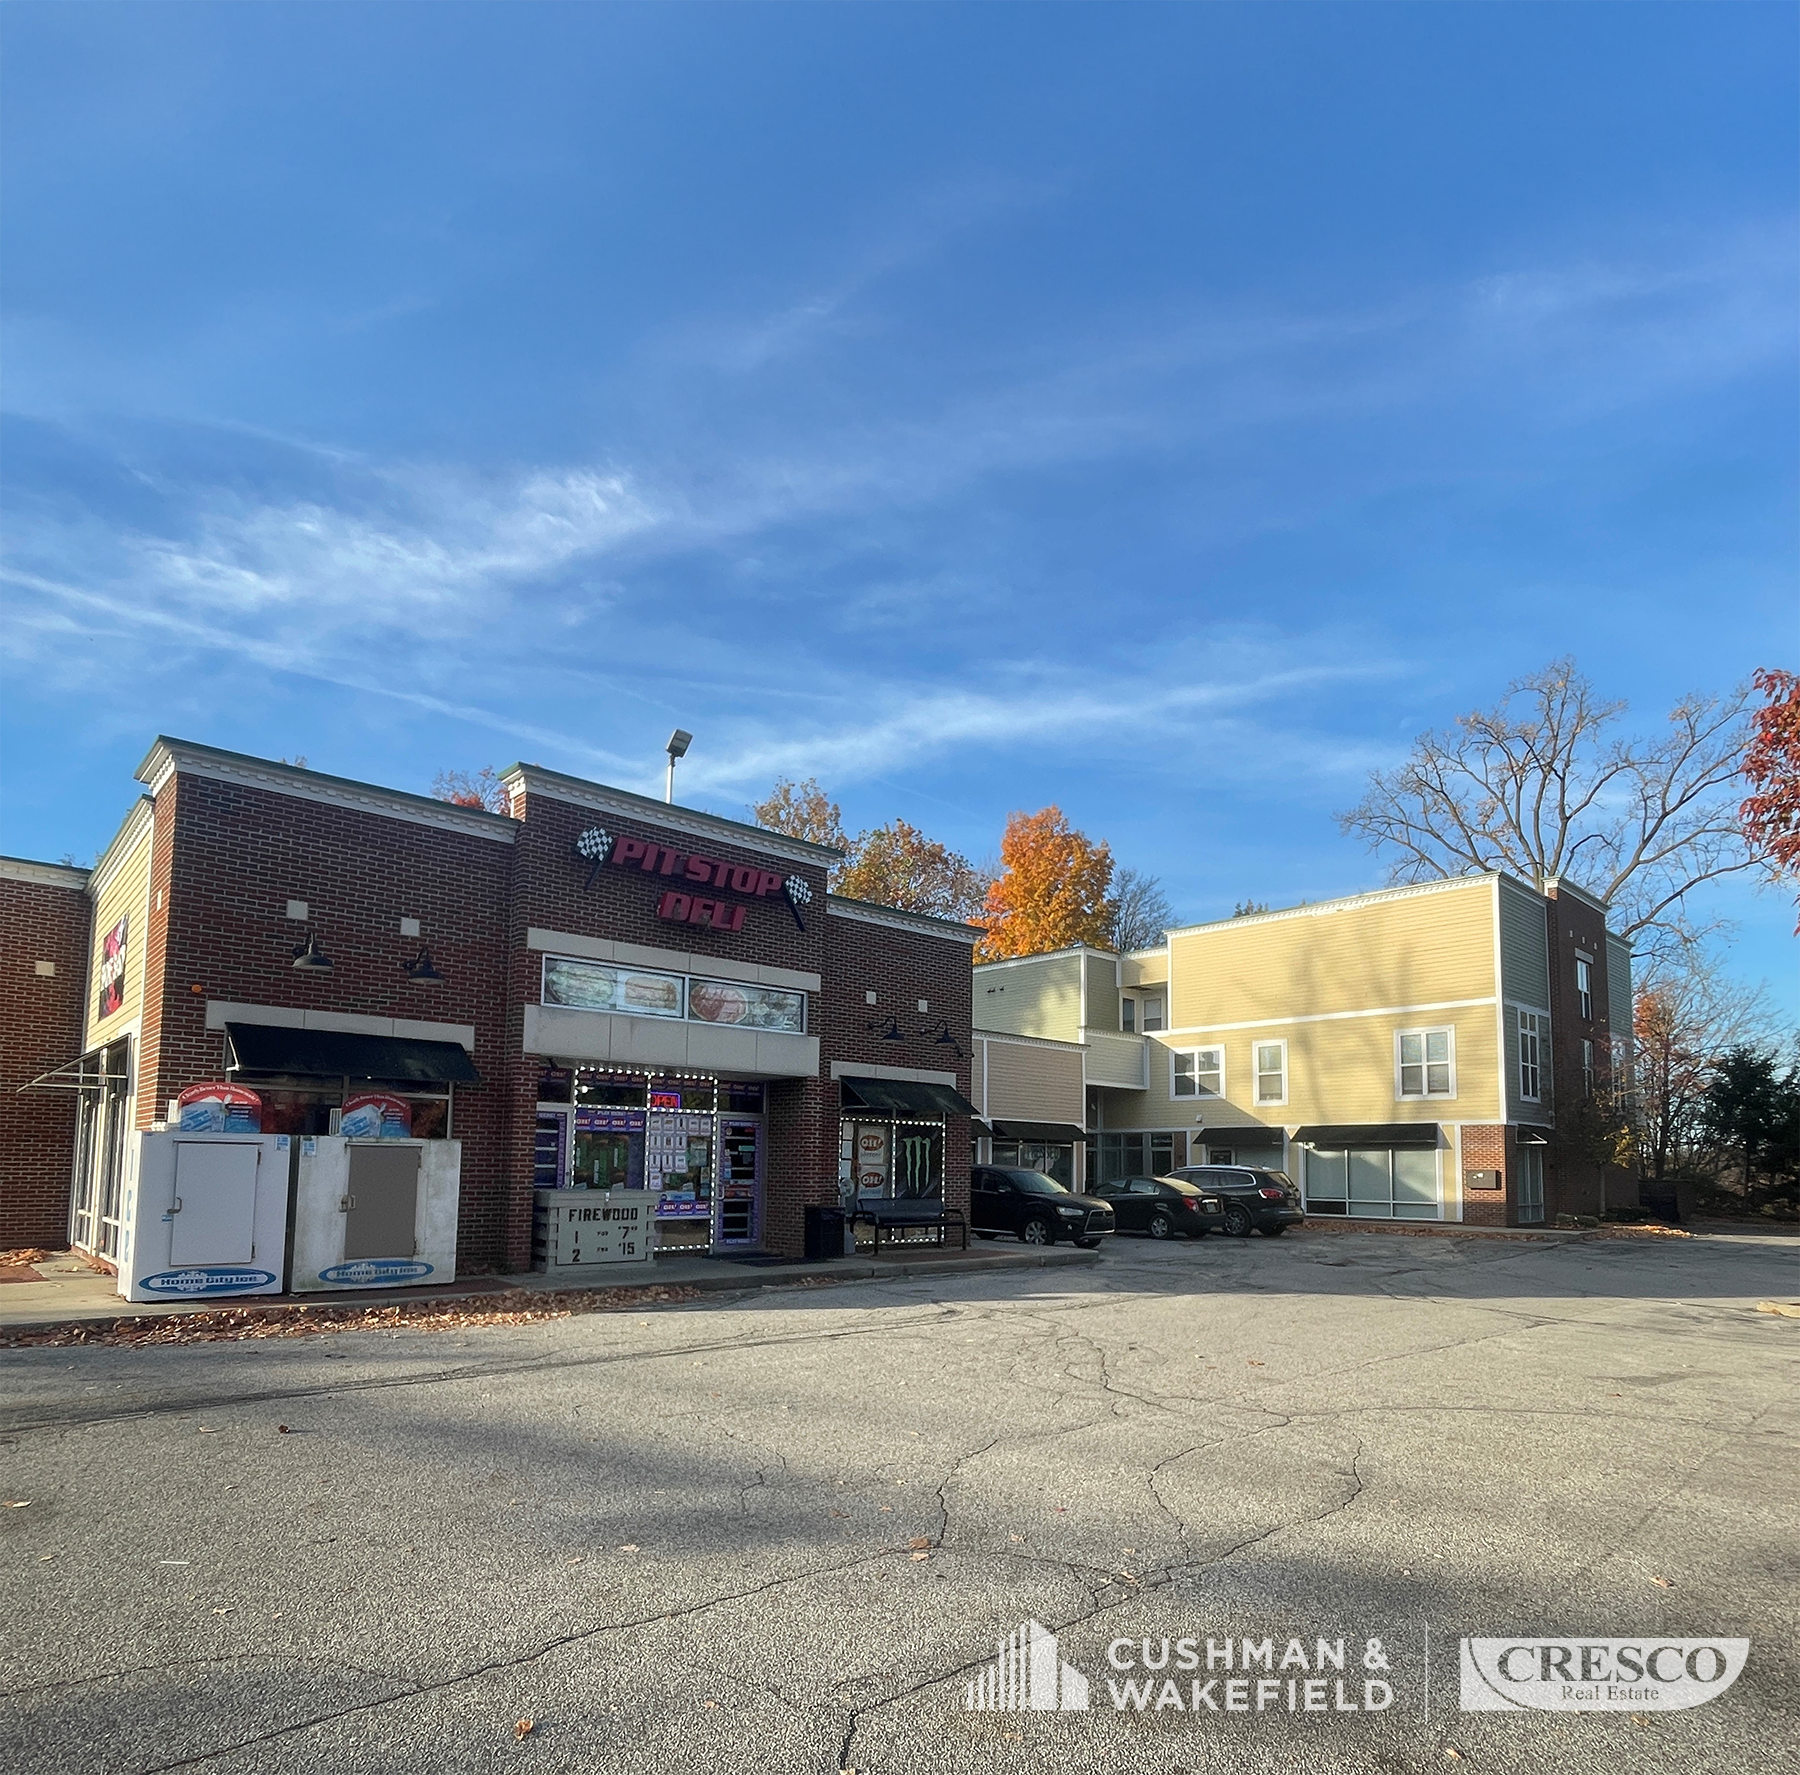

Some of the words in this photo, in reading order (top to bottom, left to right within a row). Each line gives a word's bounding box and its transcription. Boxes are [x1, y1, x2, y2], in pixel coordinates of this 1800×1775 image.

[611, 836, 683, 876] PIT
[684, 855, 783, 897] STOP
[657, 891, 747, 931] DELI
[651, 1094, 678, 1107] OPEN
[568, 1207, 638, 1222] FIREWOOD
[575, 1231, 578, 1244] 1
[572, 1249, 580, 1262] 2
[160, 1278, 203, 1286] Home
[205, 1275, 233, 1285] City
